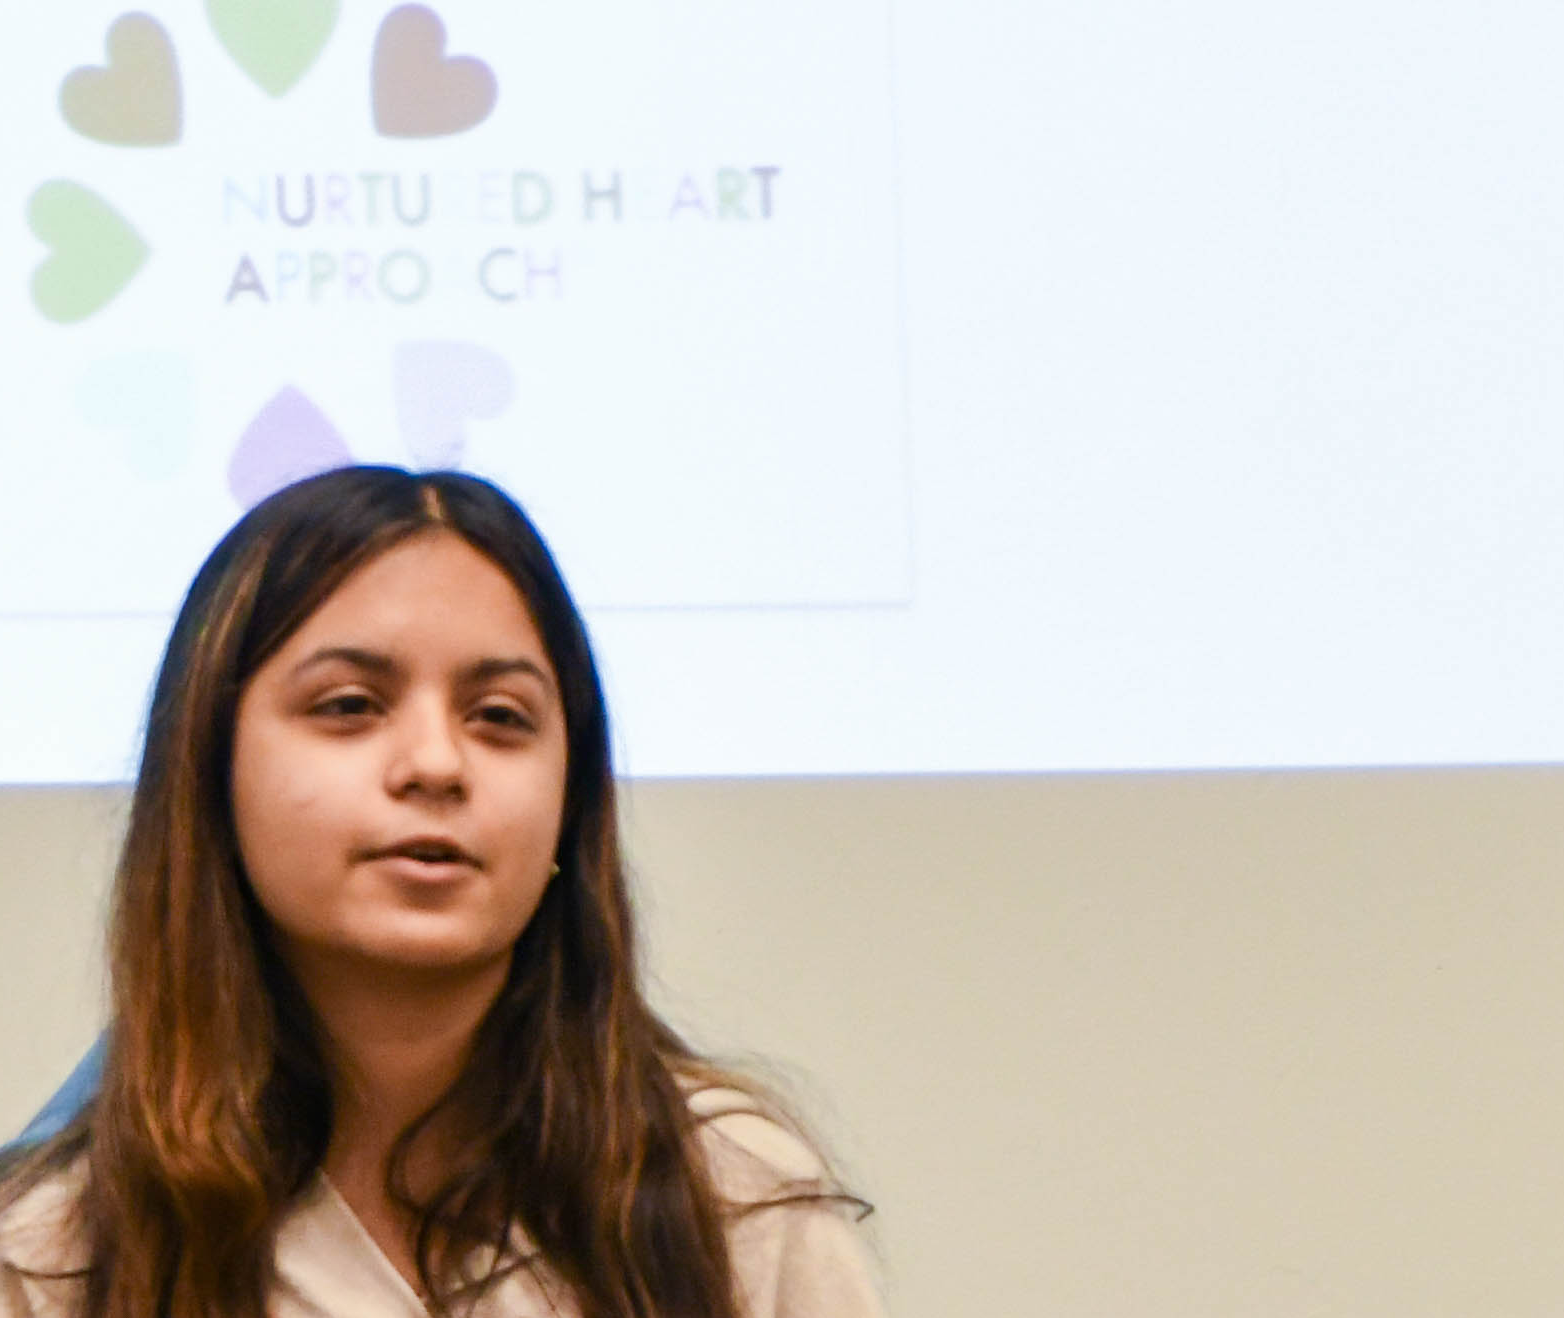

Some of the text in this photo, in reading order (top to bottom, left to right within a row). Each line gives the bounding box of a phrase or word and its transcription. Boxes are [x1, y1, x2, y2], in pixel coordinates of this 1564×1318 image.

[221, 164, 783, 227] NURTUED HART
[224, 246, 563, 304] APPROCH
